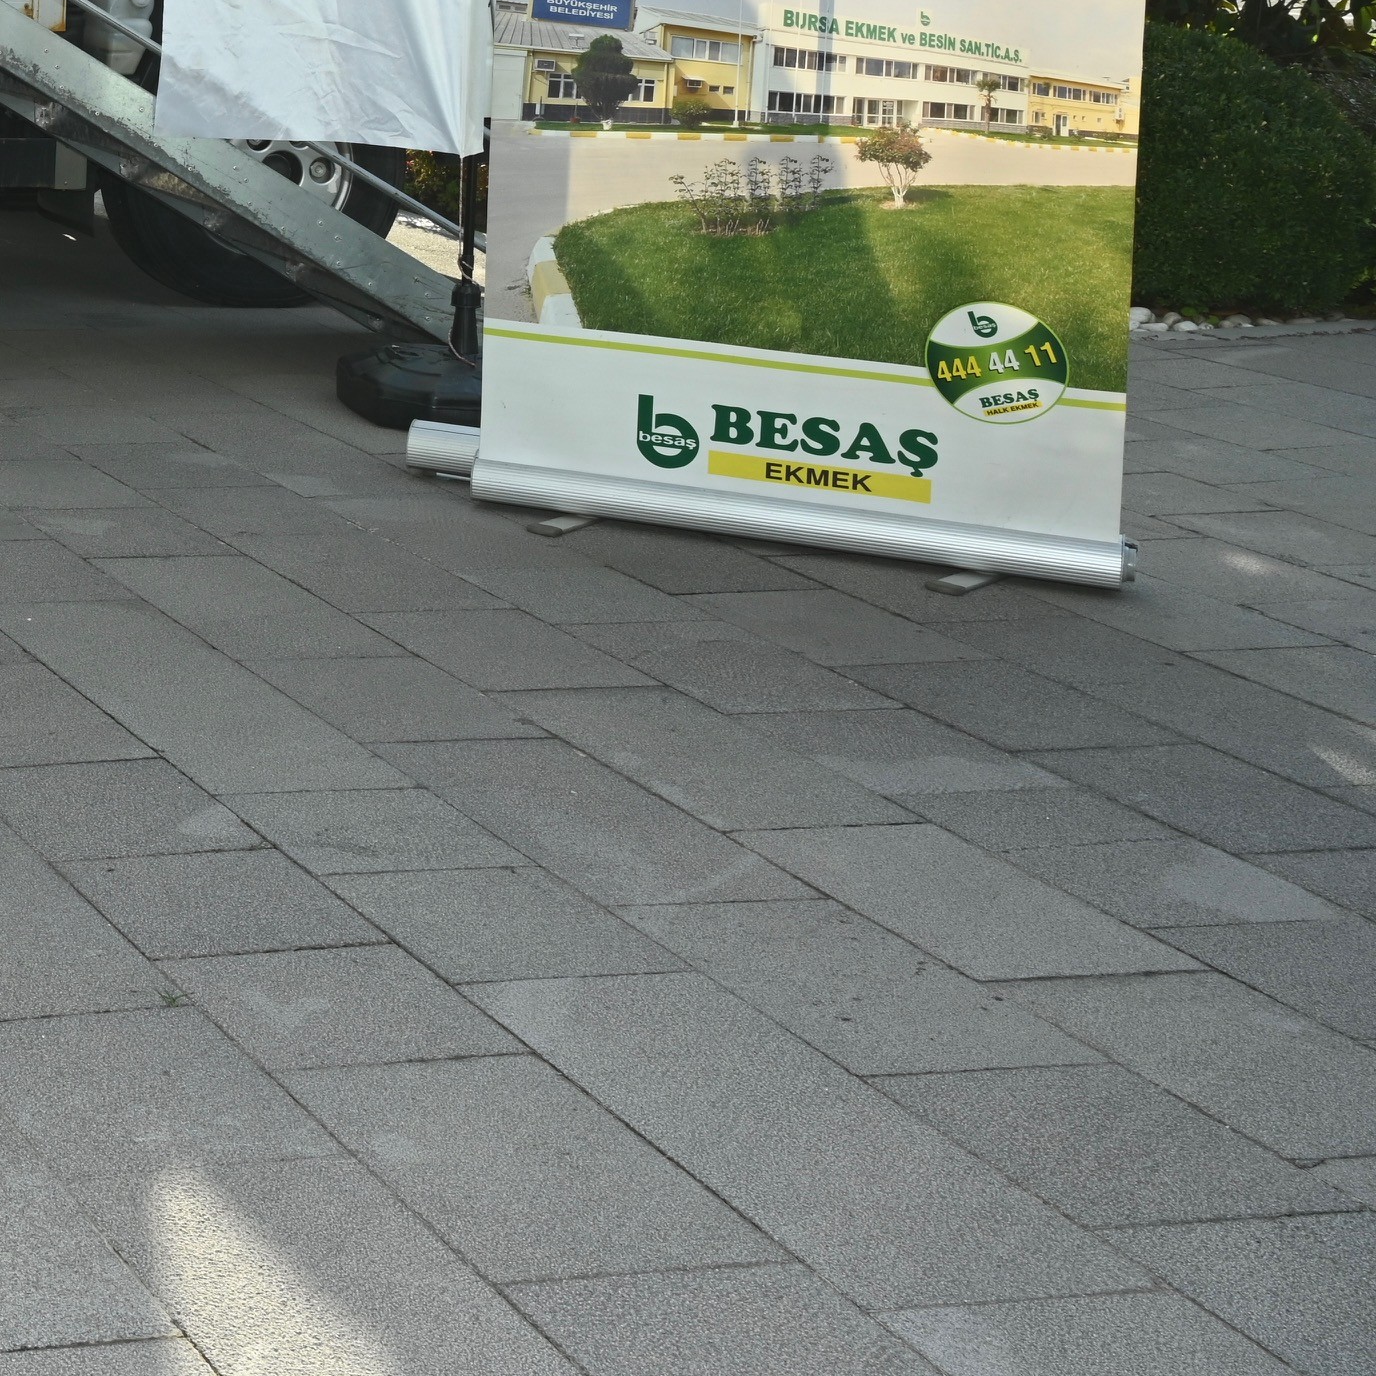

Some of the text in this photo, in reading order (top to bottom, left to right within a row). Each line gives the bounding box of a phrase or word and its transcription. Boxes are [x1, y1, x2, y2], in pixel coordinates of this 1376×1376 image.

[550, 5, 614, 20] BELEDİYESİ
[783, 9, 840, 35] BURSA
[844, 20, 897, 43] EKMEK
[901, 32, 915, 46] ve
[920, 30, 956, 52] BESİN
[938, 342, 1057, 382] 444 44 11
[979, 388, 1040, 408] BESAŞ
[986, 402, 1038, 416] HALK EKMEK
[638, 404, 939, 478] besaş BESAŞ
[765, 462, 872, 492] EKMEK
